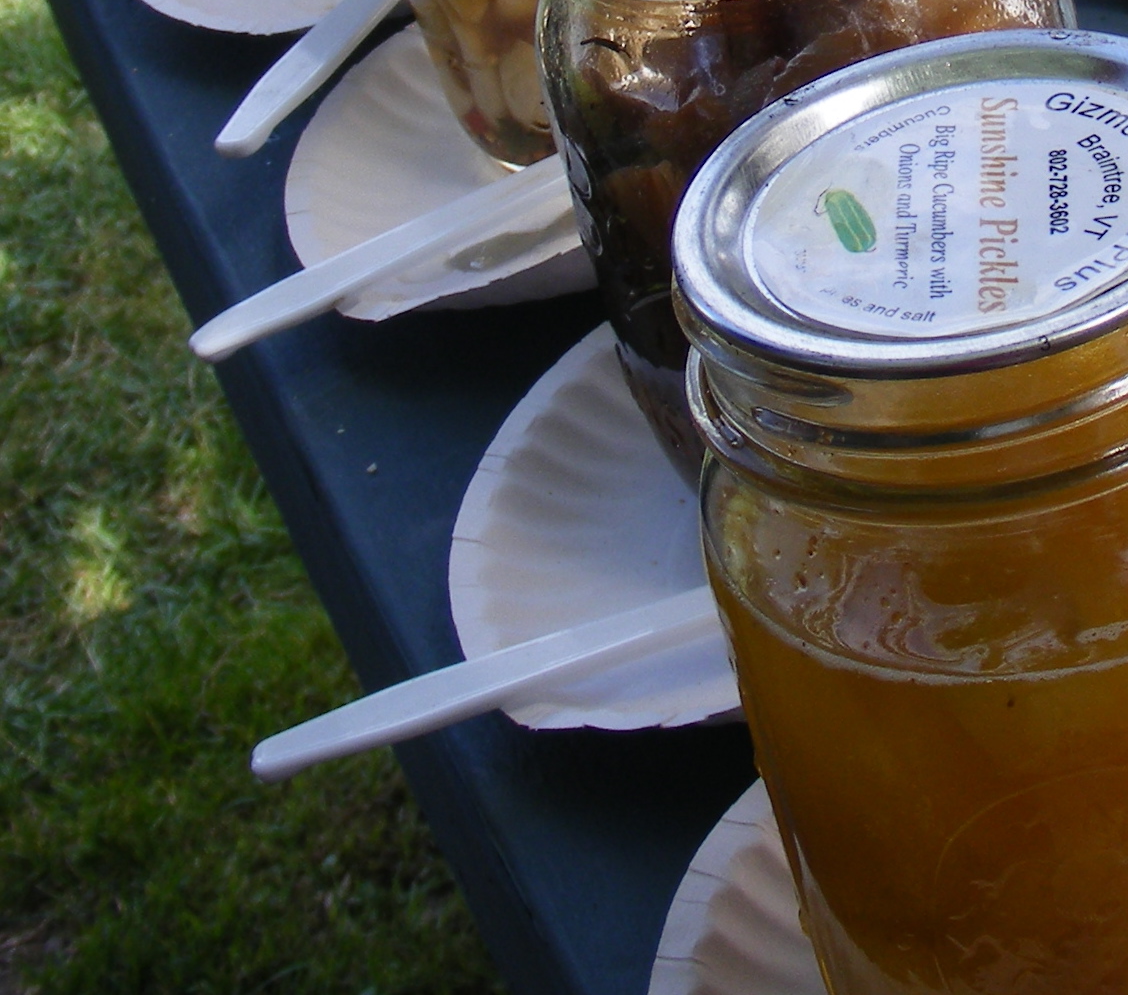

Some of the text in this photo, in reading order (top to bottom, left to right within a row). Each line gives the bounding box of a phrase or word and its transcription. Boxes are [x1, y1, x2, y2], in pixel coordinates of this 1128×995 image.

[853, 105, 951, 152] Cucumbers
[892, 142, 921, 290] Onions and Turmeric
[927, 125, 957, 300] Big Ripe Cucumbers with
[977, 97, 1020, 314] Sunshine Pickles
[1048, 148, 1070, 236] 802-728-3602
[1077, 133, 1125, 242] Braintree, VT
[862, 303, 901, 319] and
[900, 310, 937, 324] salt
